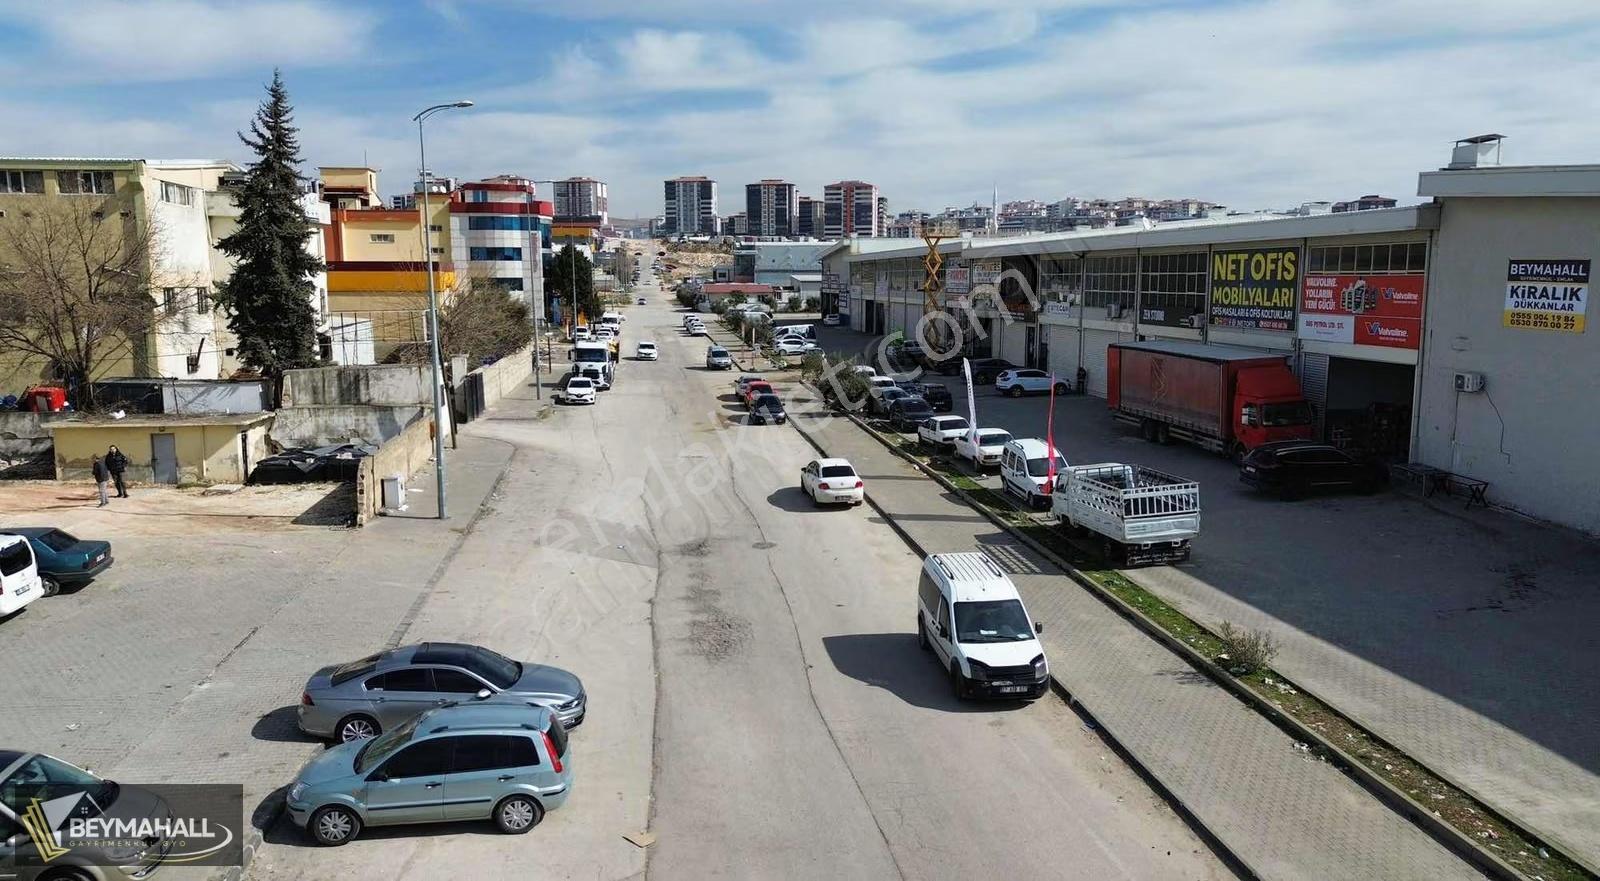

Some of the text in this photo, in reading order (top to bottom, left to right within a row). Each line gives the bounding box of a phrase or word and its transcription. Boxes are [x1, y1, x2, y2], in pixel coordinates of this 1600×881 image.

[1213, 253, 1249, 281] NET
[1510, 263, 1587, 276] BEYMAHALL
[1513, 299, 1574, 312] DÜKKANLAR
[1510, 312, 1532, 320] 0555
[1533, 313, 1549, 321] 004
[1551, 314, 1562, 322] 19
[1533, 320, 1548, 328] 870
